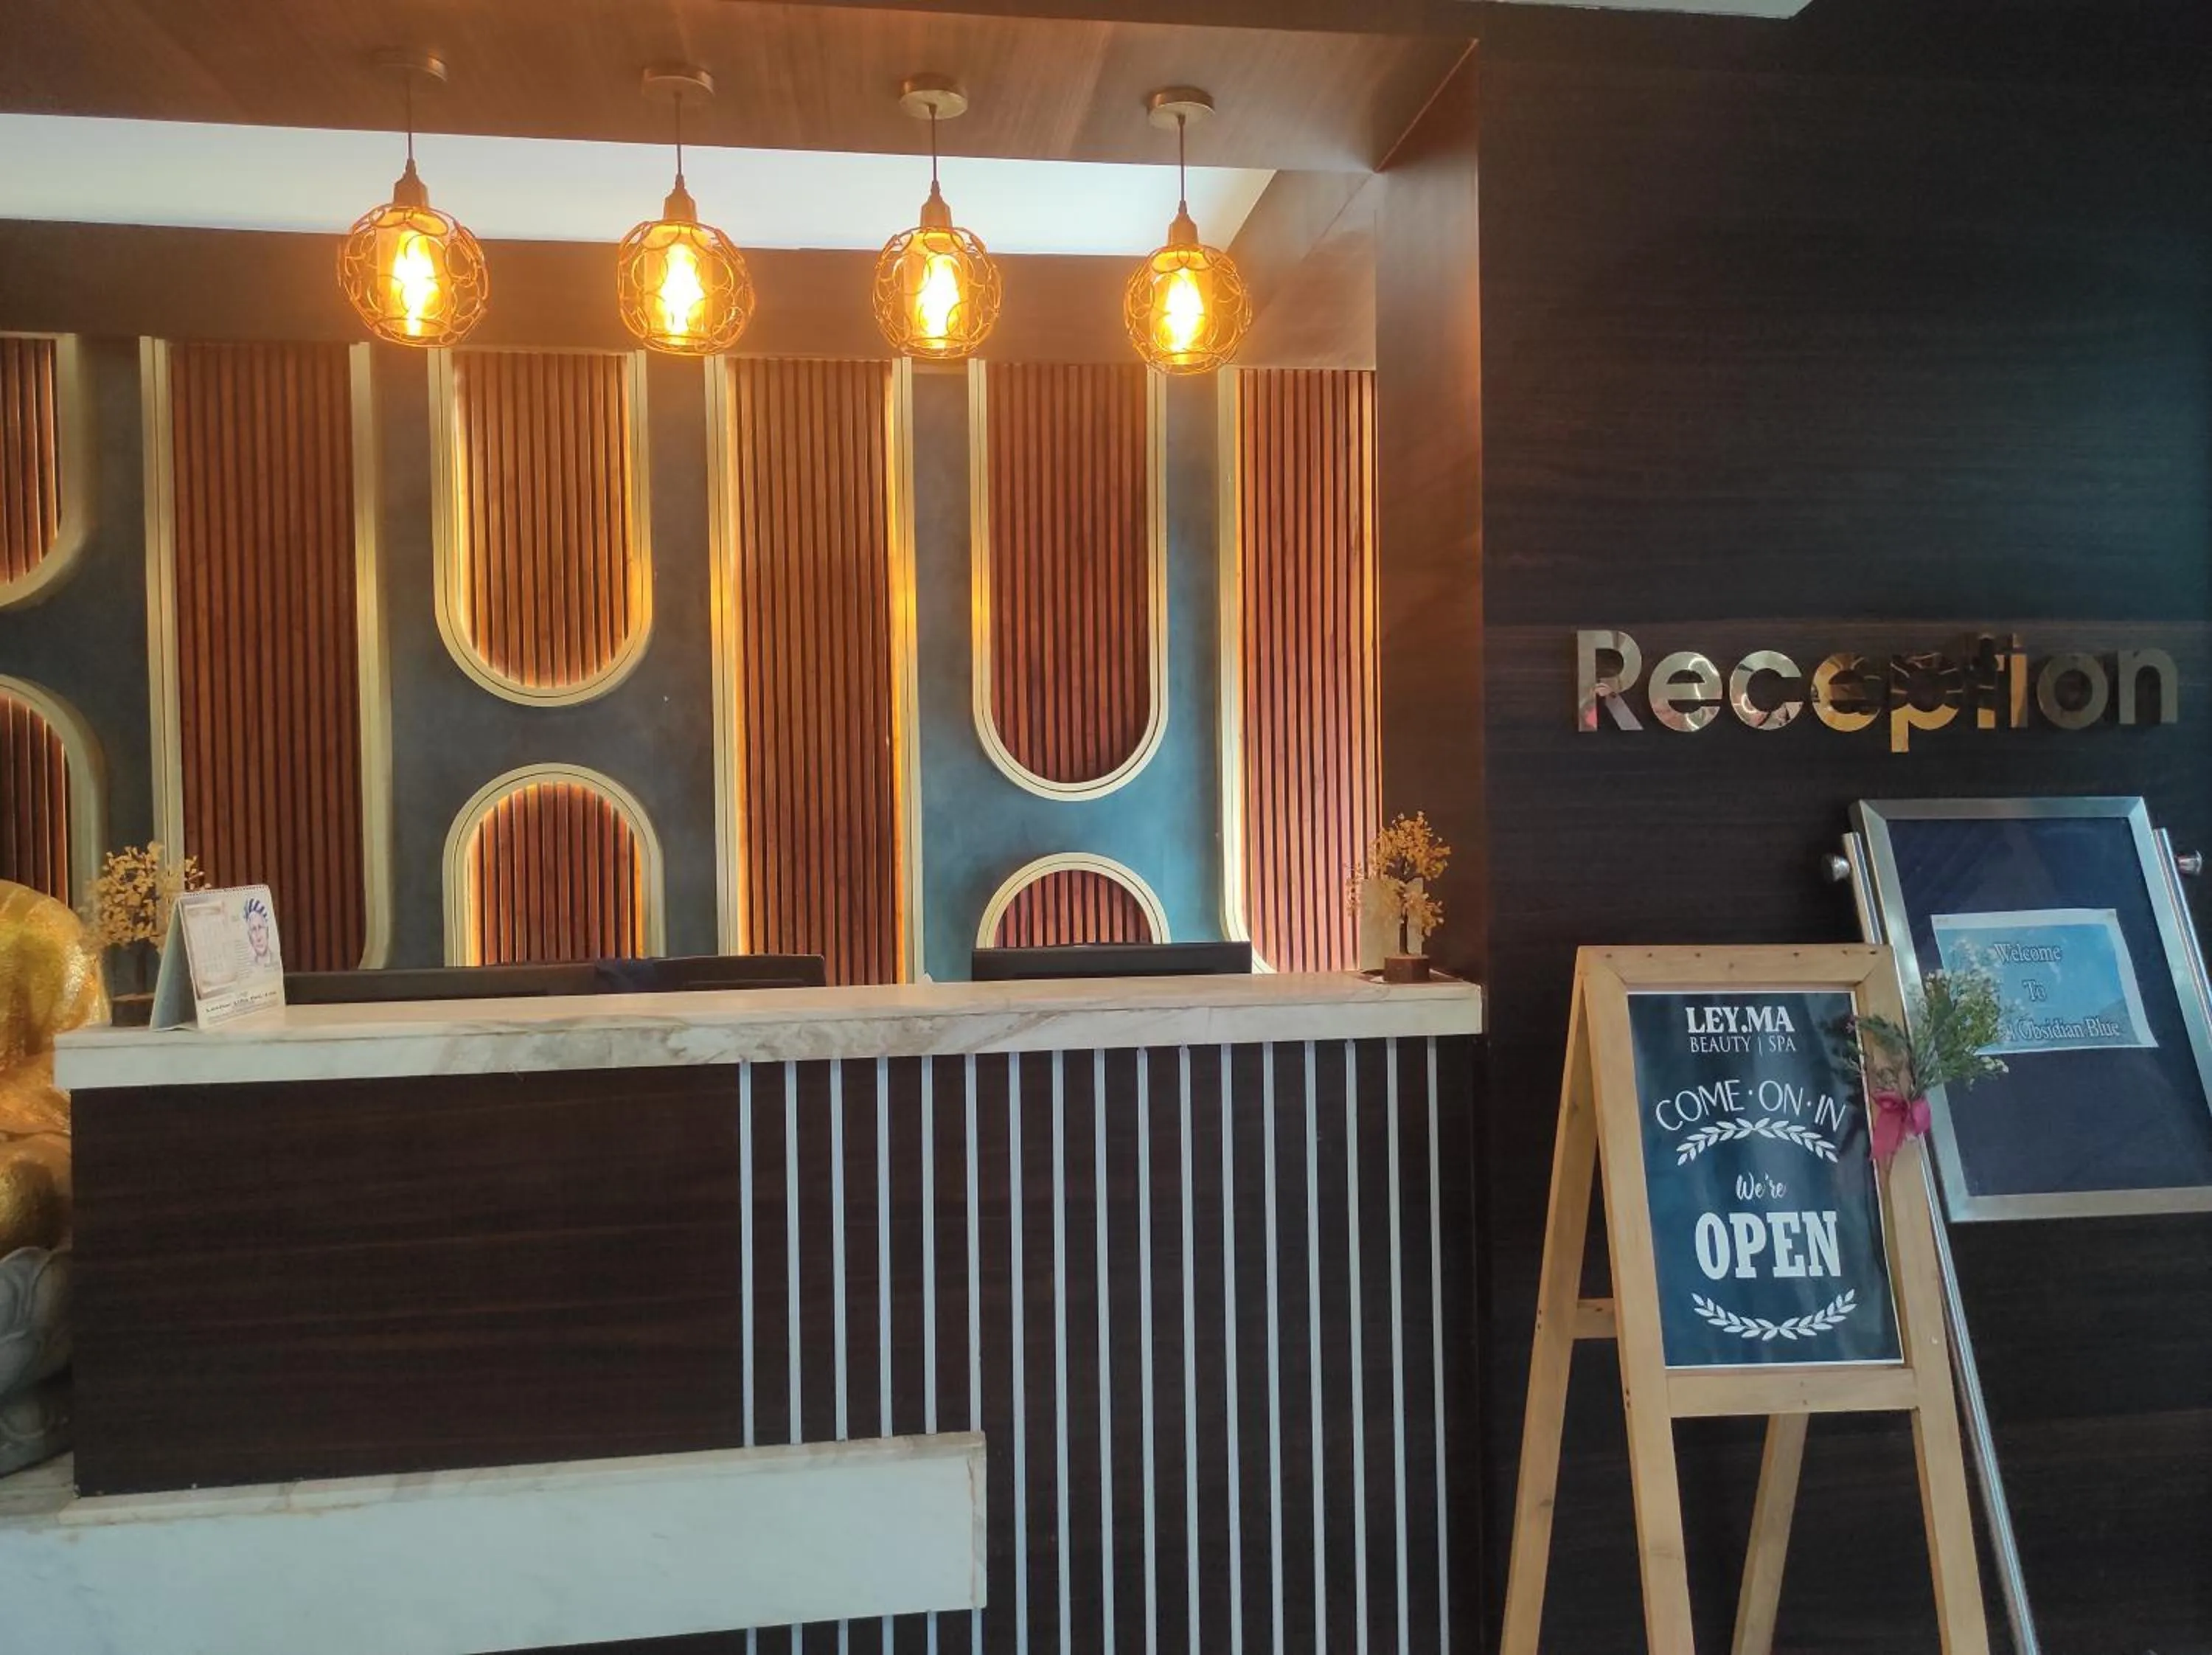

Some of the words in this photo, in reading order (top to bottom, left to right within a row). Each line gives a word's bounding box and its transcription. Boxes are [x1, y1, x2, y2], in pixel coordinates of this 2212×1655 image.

[1577, 629, 2179, 753] Reception
[1993, 942, 2062, 962] Welcome
[2023, 979, 2047, 1001] To
[1686, 1006, 1795, 1033] LEY.MA
[2018, 1017, 2084, 1040] Obsidian
[2084, 1015, 2121, 1036] Blue
[1690, 1037, 1750, 1053] BEAUTY
[1769, 1035, 1796, 1052] SPA
[1655, 1079, 1745, 1131] COME
[1759, 1080, 1804, 1116] ON
[1814, 1094, 1846, 1132] IN
[1736, 1173, 1787, 1200] We're
[1694, 1210, 1842, 1280] OPEN
